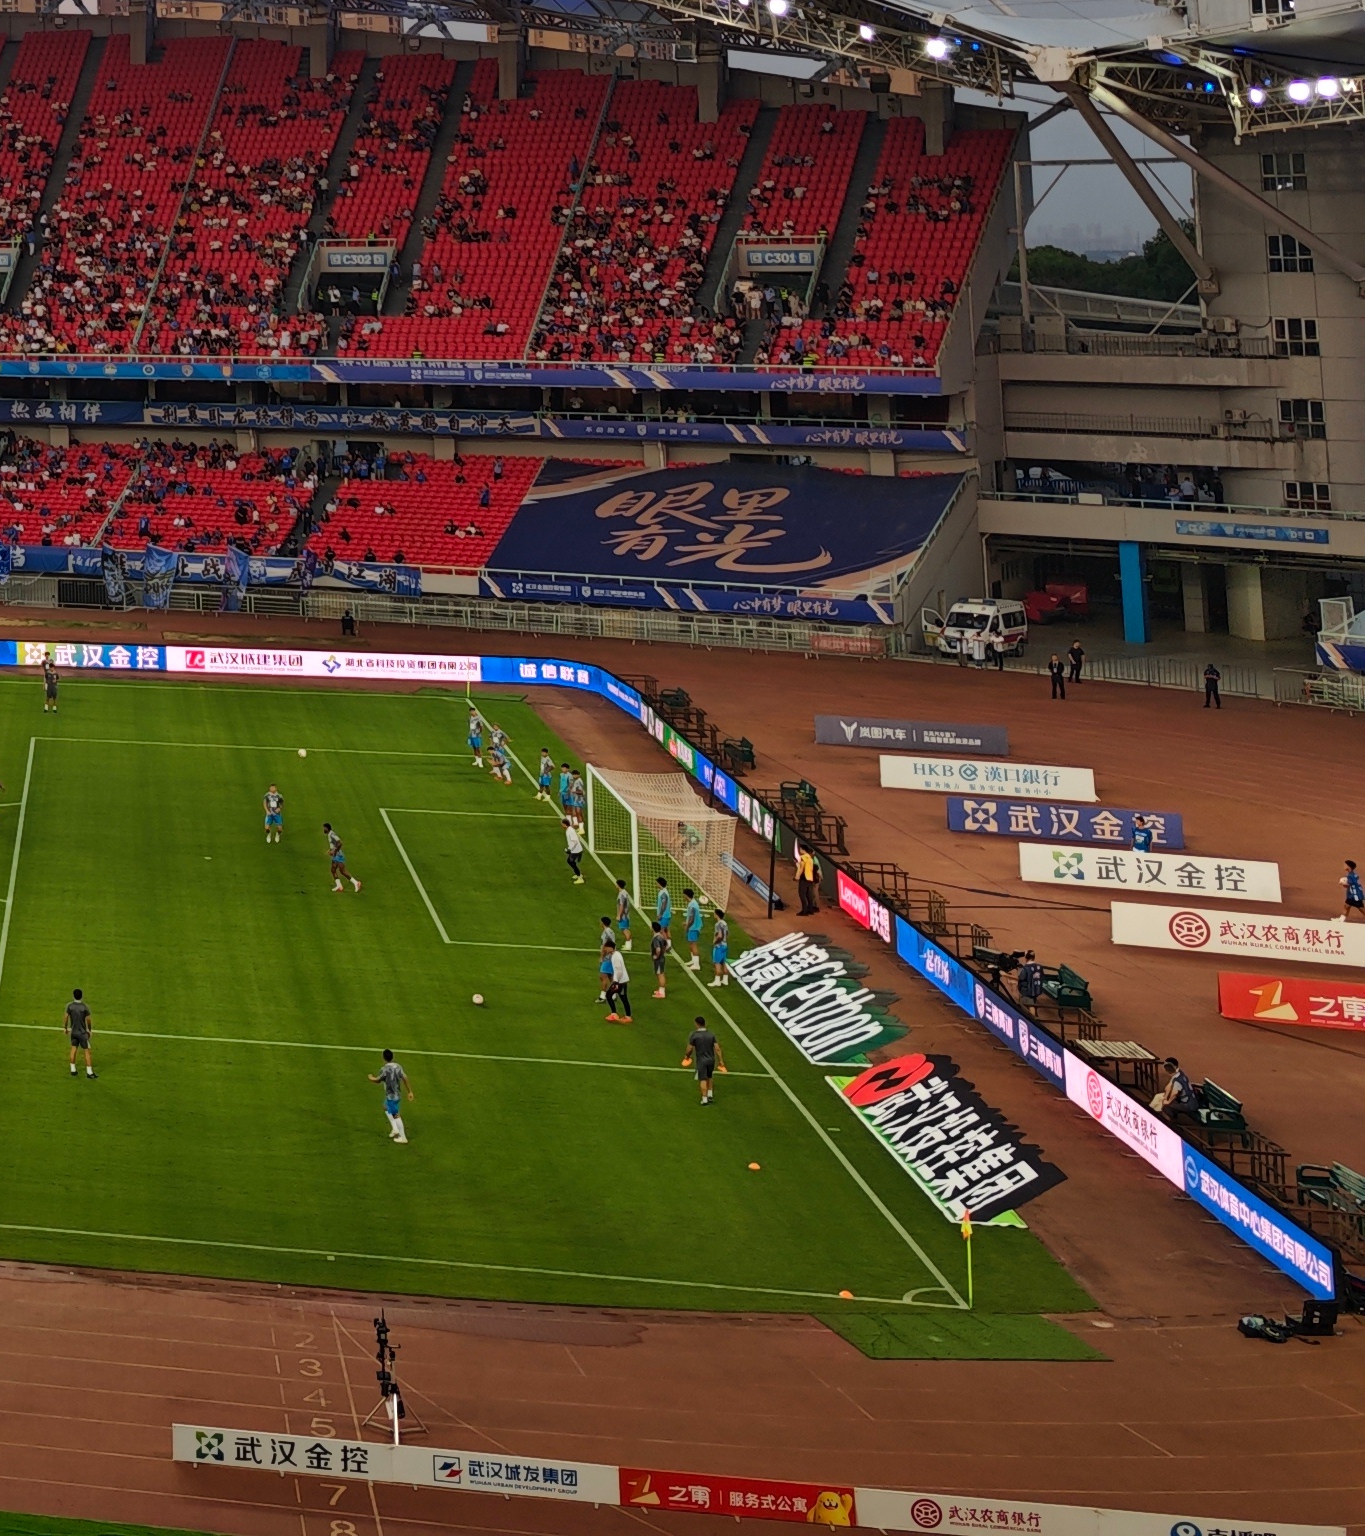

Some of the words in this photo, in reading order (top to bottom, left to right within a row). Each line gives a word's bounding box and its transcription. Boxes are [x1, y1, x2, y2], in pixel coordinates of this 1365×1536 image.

[764, 252, 796, 263] C301
[771, 375, 816, 390] 心中有梦
[818, 375, 865, 391] 眼里有光
[10, 400, 103, 422] 热血相伴
[161, 405, 319, 428] 荆襄卧龙终得雨
[345, 410, 517, 434] 江城黄鹤自冲天
[806, 430, 852, 444] 心中有梦
[854, 430, 903, 445] 眼里有光
[733, 596, 785, 612] 心中有梦
[786, 598, 839, 616] 眼里有光
[54, 643, 160, 670] 武汉金控
[210, 652, 303, 667] 武汉城建集团
[860, 725, 907, 741] 岚图汽车
[912, 762, 954, 778] HKB
[984, 765, 1061, 786] 漢口銀行
[1008, 805, 1168, 845] 武汉金控
[1095, 855, 1248, 893] 武汉金控
[839, 882, 867, 916] Lenovo
[868, 896, 891, 943] 联想
[1219, 920, 1345, 948] 武汉农商银行
[1221, 938, 1248, 947] WUHAN
[1275, 944, 1322, 955] COMMERCIAL
[1106, 1092, 1158, 1149] 武汉农商银行
[1199, 1169, 1332, 1292] 武汉体育中心集团有限公司
[294, 1331, 318, 1348] 2
[299, 1358, 324, 1378] 3
[303, 1388, 332, 1407] 4
[310, 1417, 337, 1438] 5
[234, 1435, 370, 1474] 武汉金控
[468, 1459, 578, 1487] 武汉城发集团
[319, 1483, 348, 1506] 7
[469, 1479, 492, 1487] WUHAN
[493, 1481, 513, 1489] URBAN
[514, 1482, 556, 1493] DEVELOPMENT
[557, 1487, 578, 1495] GROUP
[668, 1485, 712, 1509] 之寓
[729, 1492, 808, 1513] 服务式公寓
[948, 1505, 1042, 1528] 武汉农商银行
